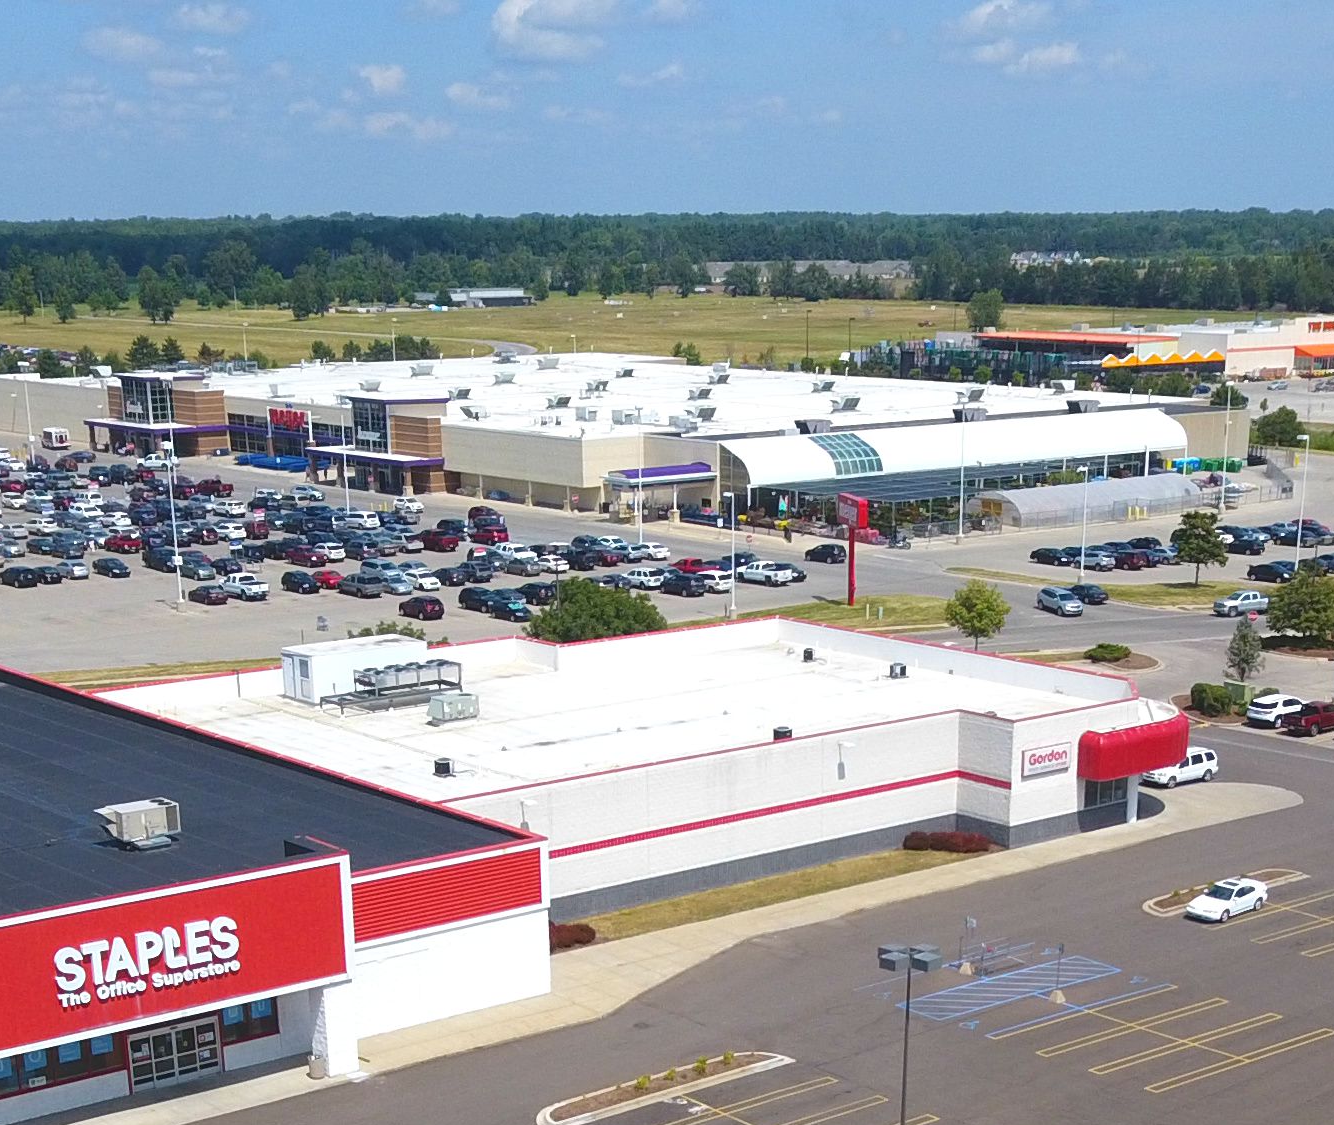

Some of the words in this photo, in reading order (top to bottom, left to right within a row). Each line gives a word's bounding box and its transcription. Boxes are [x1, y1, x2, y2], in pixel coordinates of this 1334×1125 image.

[1029, 750, 1067, 765] Gordon
[54, 916, 239, 990] STAPLES
[57, 991, 91, 1008] The
[96, 978, 147, 1001] Office
[152, 960, 240, 987] Superstore
